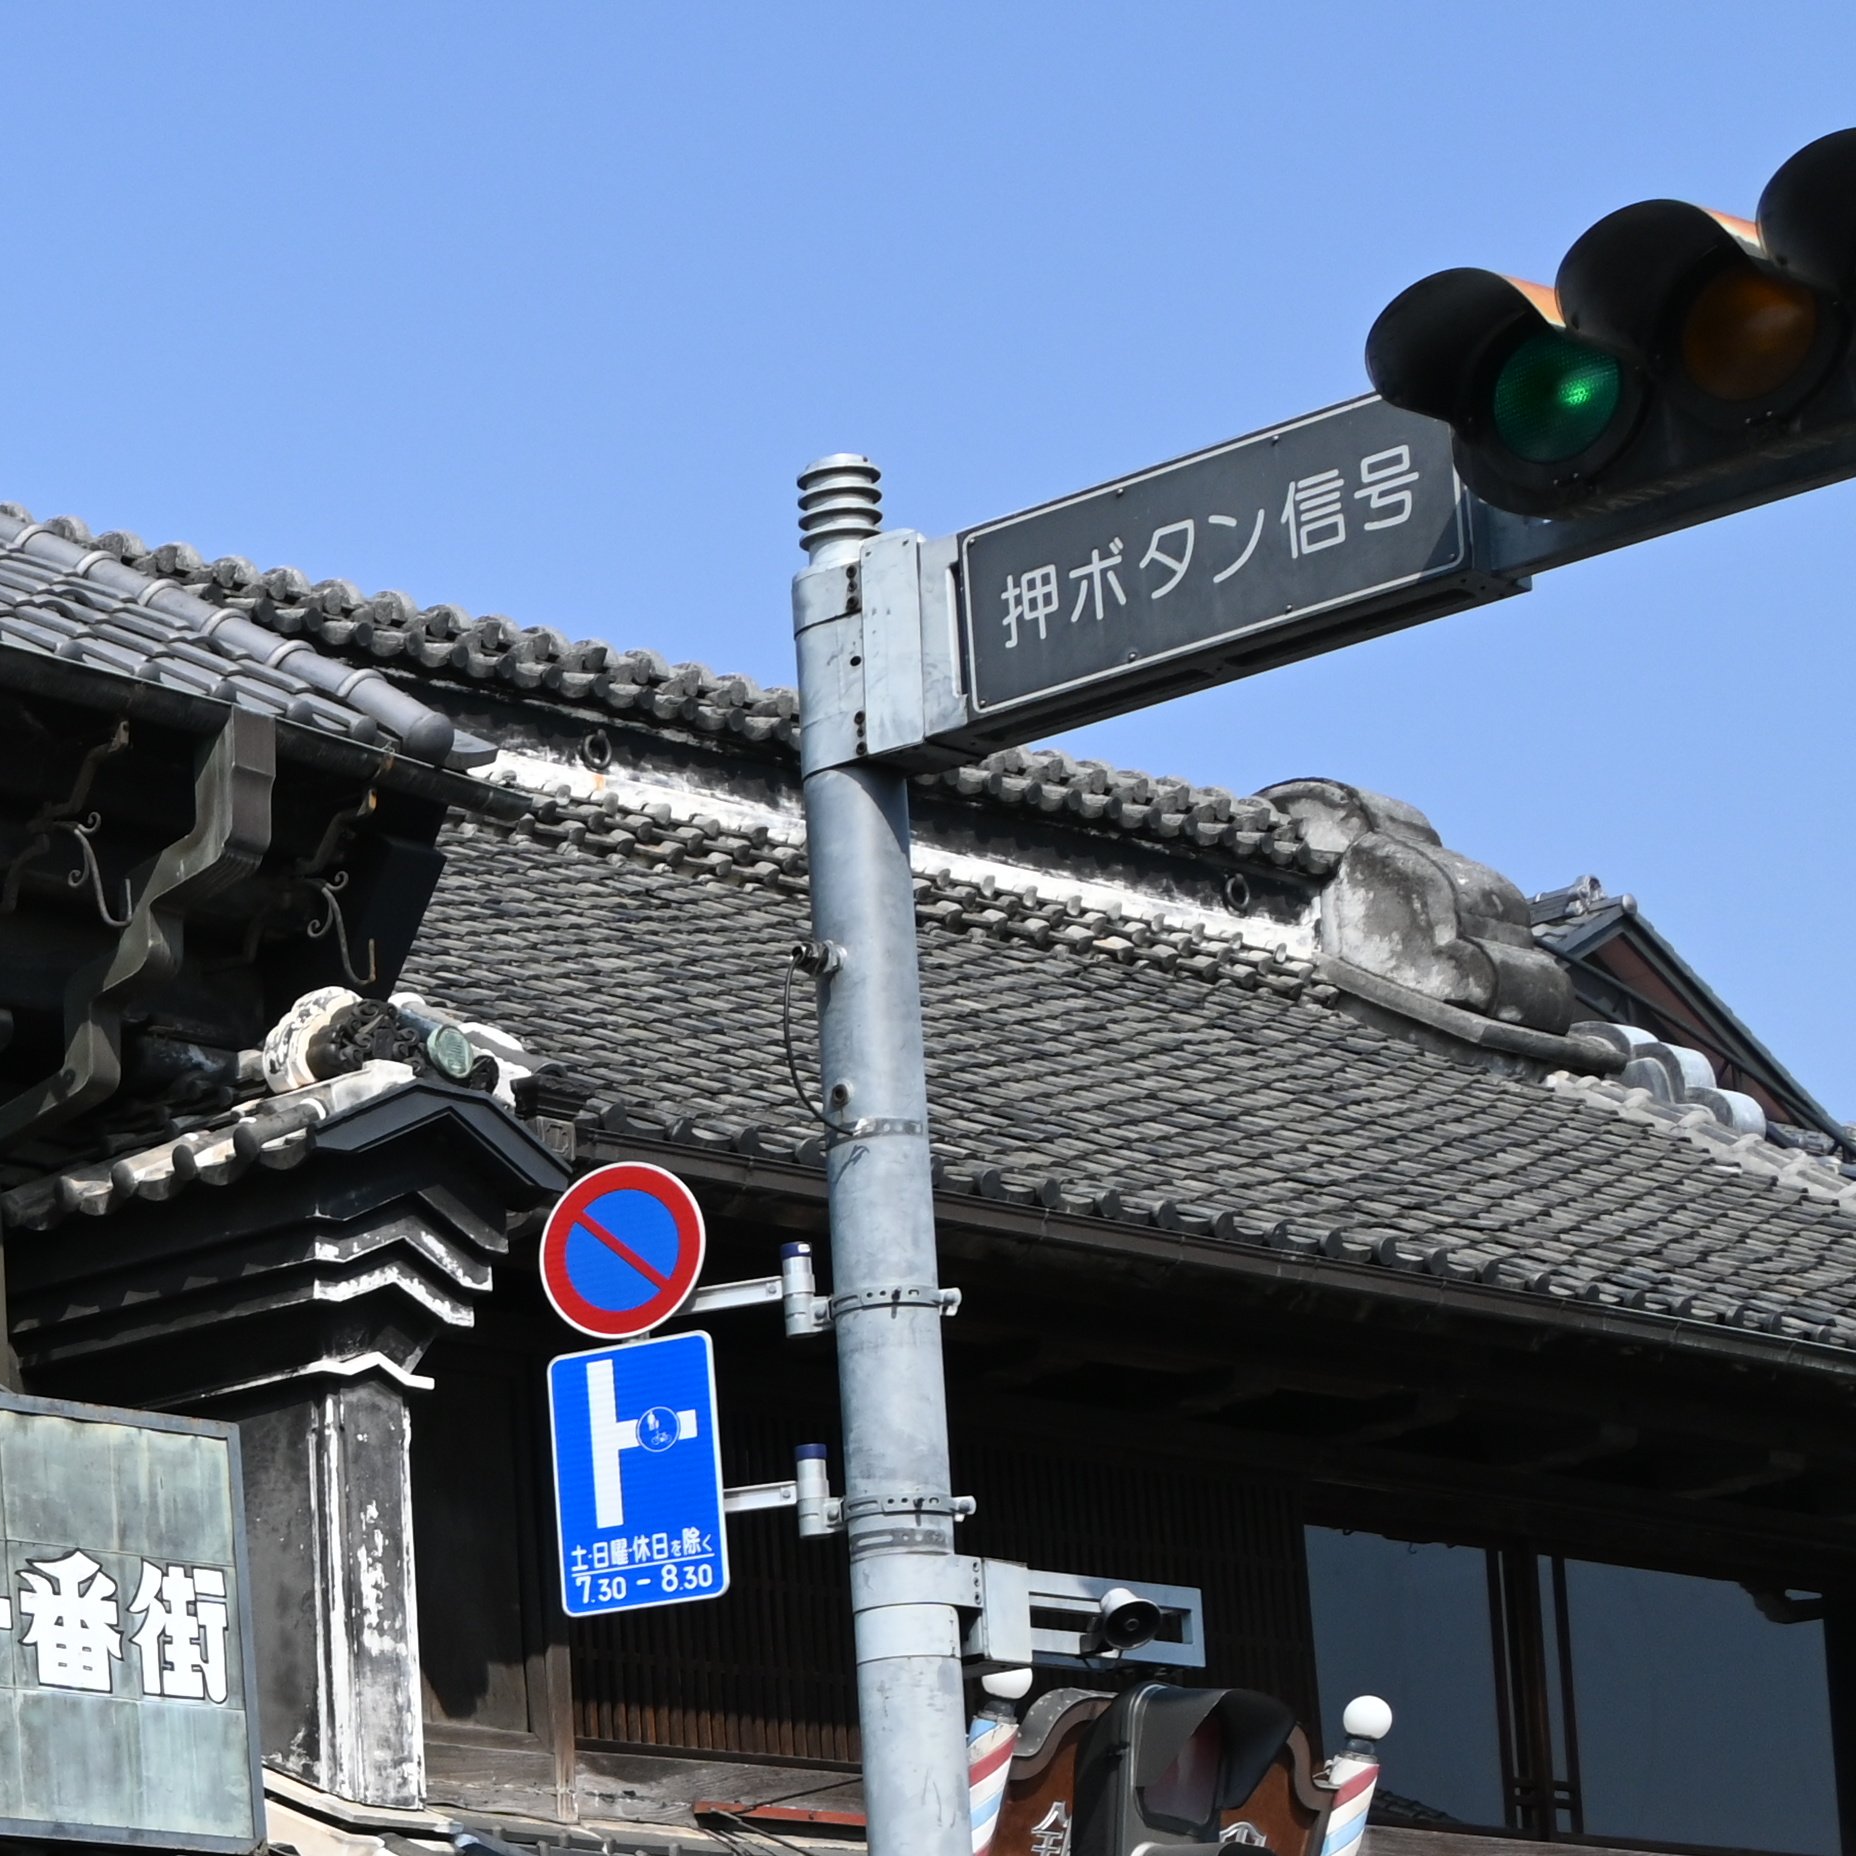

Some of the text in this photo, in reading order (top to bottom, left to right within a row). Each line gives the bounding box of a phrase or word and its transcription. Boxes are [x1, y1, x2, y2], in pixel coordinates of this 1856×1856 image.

[1001, 443, 1419, 650] 押ボタン信号
